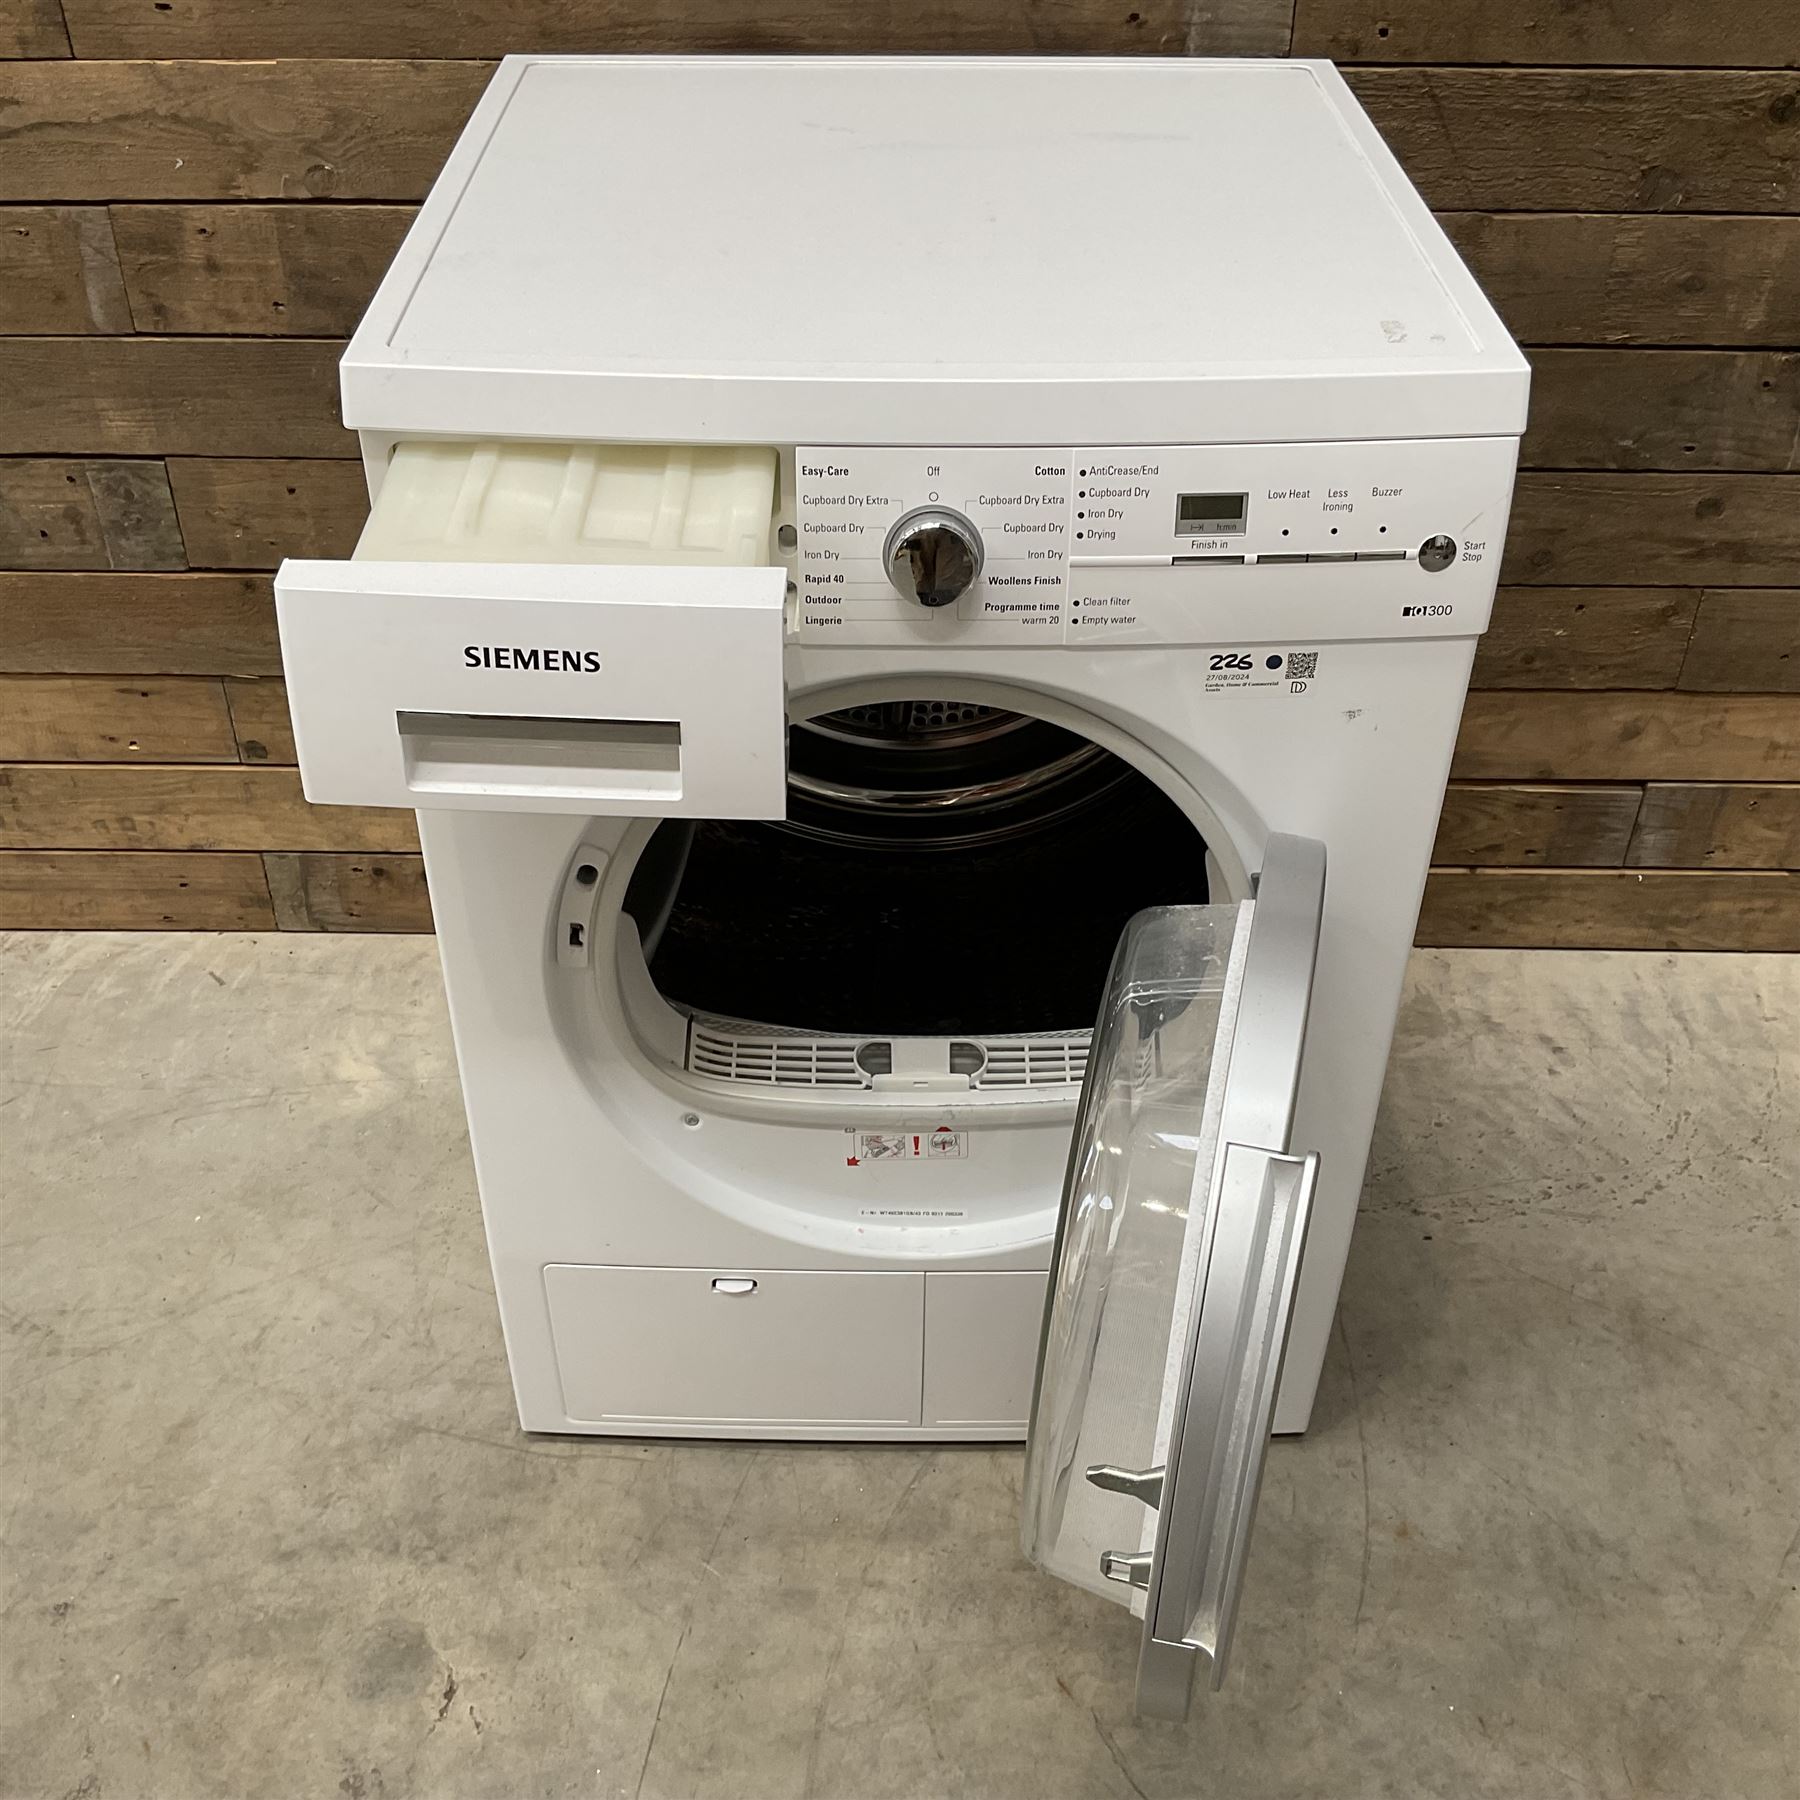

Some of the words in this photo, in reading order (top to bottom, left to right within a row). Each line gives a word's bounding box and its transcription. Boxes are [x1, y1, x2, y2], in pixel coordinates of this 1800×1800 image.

[802, 466, 849, 477] Easy-Care
[927, 466, 940, 476] Off
[1035, 466, 1065, 476] Cotton
[1089, 465, 1159, 476] AntiCrease/End
[1089, 488, 1132, 499] Cupboard
[1134, 488, 1150, 498] Dry
[1268, 490, 1287, 499] Low
[1289, 489, 1310, 499] Heat
[1328, 489, 1348, 497] Less
[1372, 487, 1402, 497] Buzzer
[802, 495, 845, 506] Cupboard
[848, 496, 864, 506] Dry
[866, 496, 889, 505] Extra
[979, 495, 1021, 506] Cupboard
[1024, 495, 1039, 506] Dry
[1042, 495, 1065, 505] Extra
[1323, 502, 1353, 512] Ironing
[1088, 509, 1106, 518] Iron
[1108, 510, 1123, 520] Dry
[804, 523, 846, 534] Cupboard
[849, 524, 864, 534] Dry
[1003, 523, 1046, 534] Cupboard
[1048, 523, 1064, 534] Dry
[1087, 530, 1116, 540] Drying
[1191, 540, 1217, 550] Finish
[1220, 540, 1228, 549] in
[1464, 541, 1485, 550] Start
[804, 550, 821, 560] Iron
[824, 551, 840, 561] Dry
[1028, 550, 1045, 559] Iron
[1047, 550, 1063, 560] Dry
[1462, 553, 1482, 562] Stop
[805, 575, 831, 585] Rapid
[834, 575, 844, 583] 40
[988, 576, 1032, 585] Woollens
[1034, 576, 1061, 585] Finish
[805, 595, 842, 605] Outdoor
[1083, 598, 1108, 607] Clean
[1110, 598, 1130, 606] filter
[985, 602, 1040, 613] Programme
[1042, 603, 1060, 612] time
[805, 616, 842, 627] Lingerie
[1022, 617, 1046, 625] warm
[1049, 616, 1059, 625] 20
[1082, 616, 1109, 626] Empty
[1111, 617, 1136, 625] water
[464, 646, 600, 673] SIEMENS
[1209, 653, 1253, 670] 226
